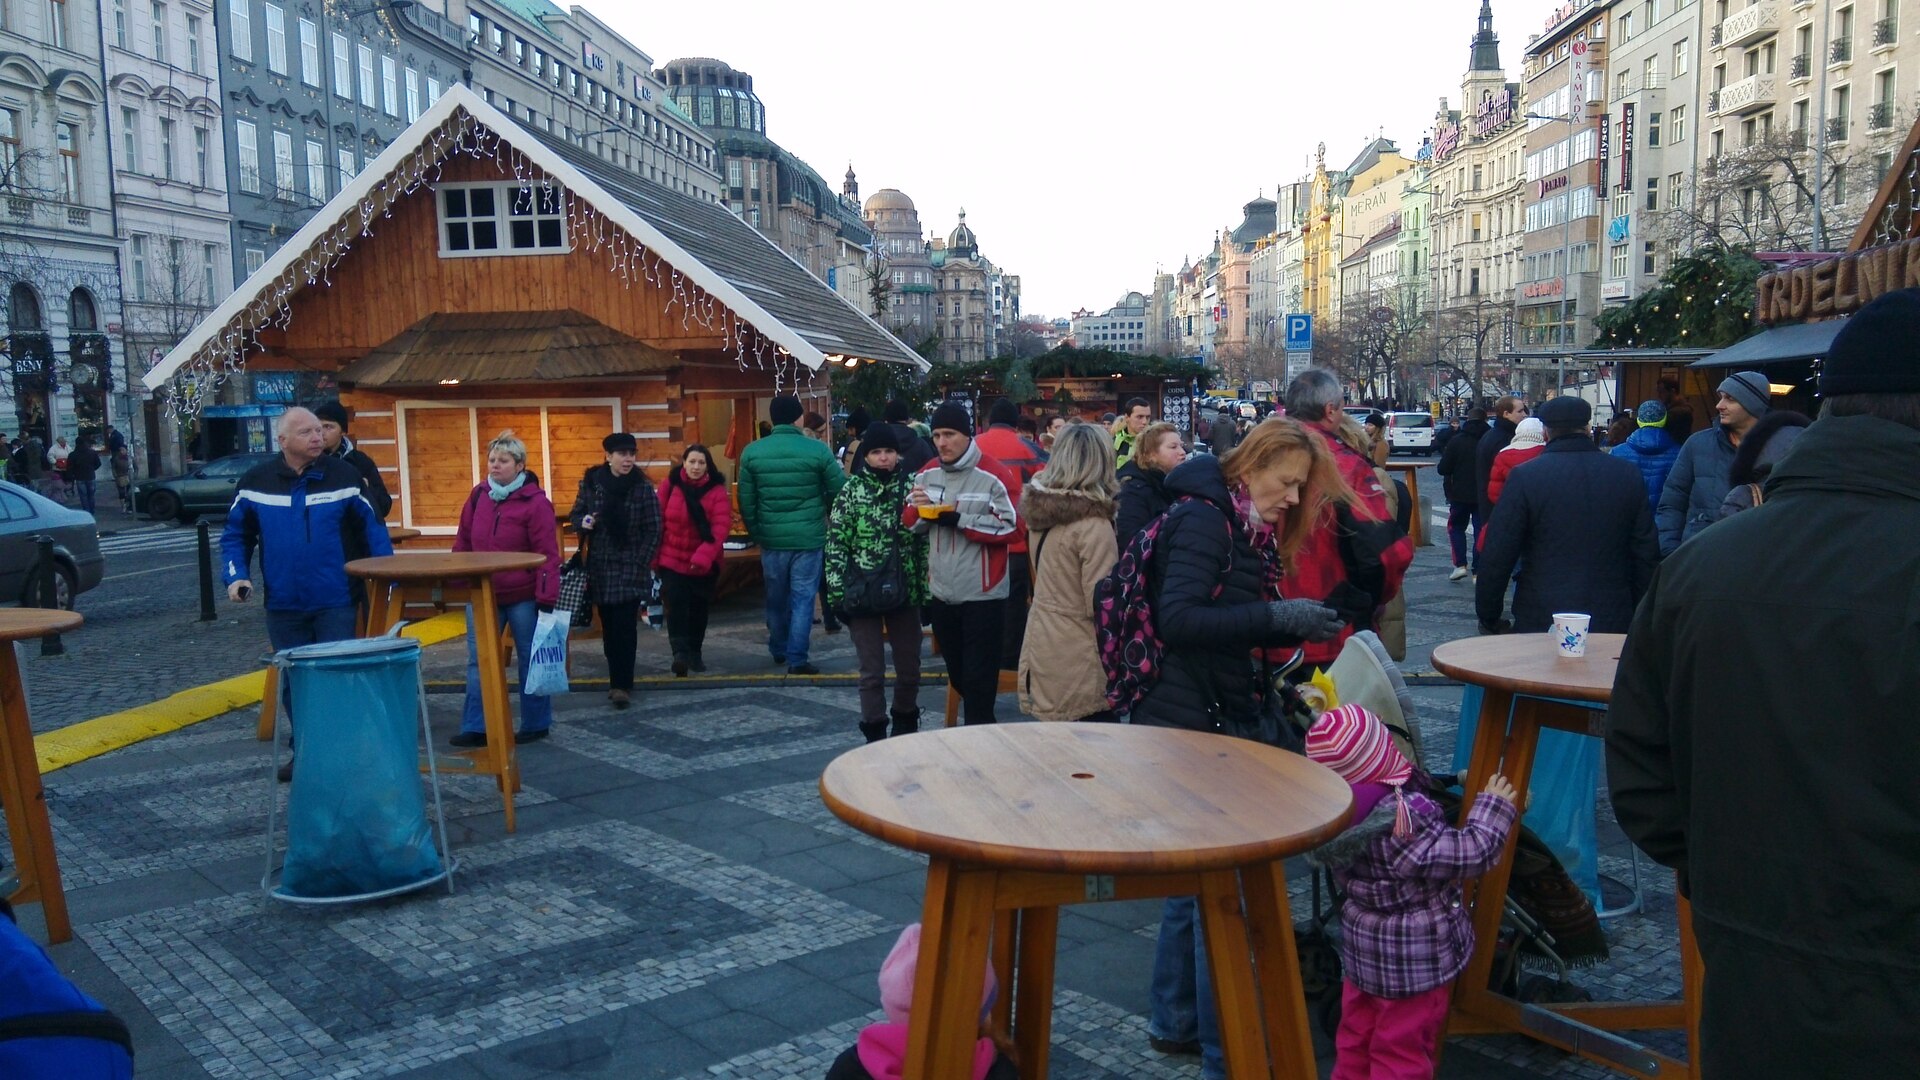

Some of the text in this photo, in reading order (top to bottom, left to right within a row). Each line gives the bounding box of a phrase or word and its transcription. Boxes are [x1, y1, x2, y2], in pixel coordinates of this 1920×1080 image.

[1573, 61, 1583, 124] RAMADA
[1351, 192, 1386, 216] MERAN
[1292, 319, 1307, 339] P
[16, 360, 43, 372] BENY
